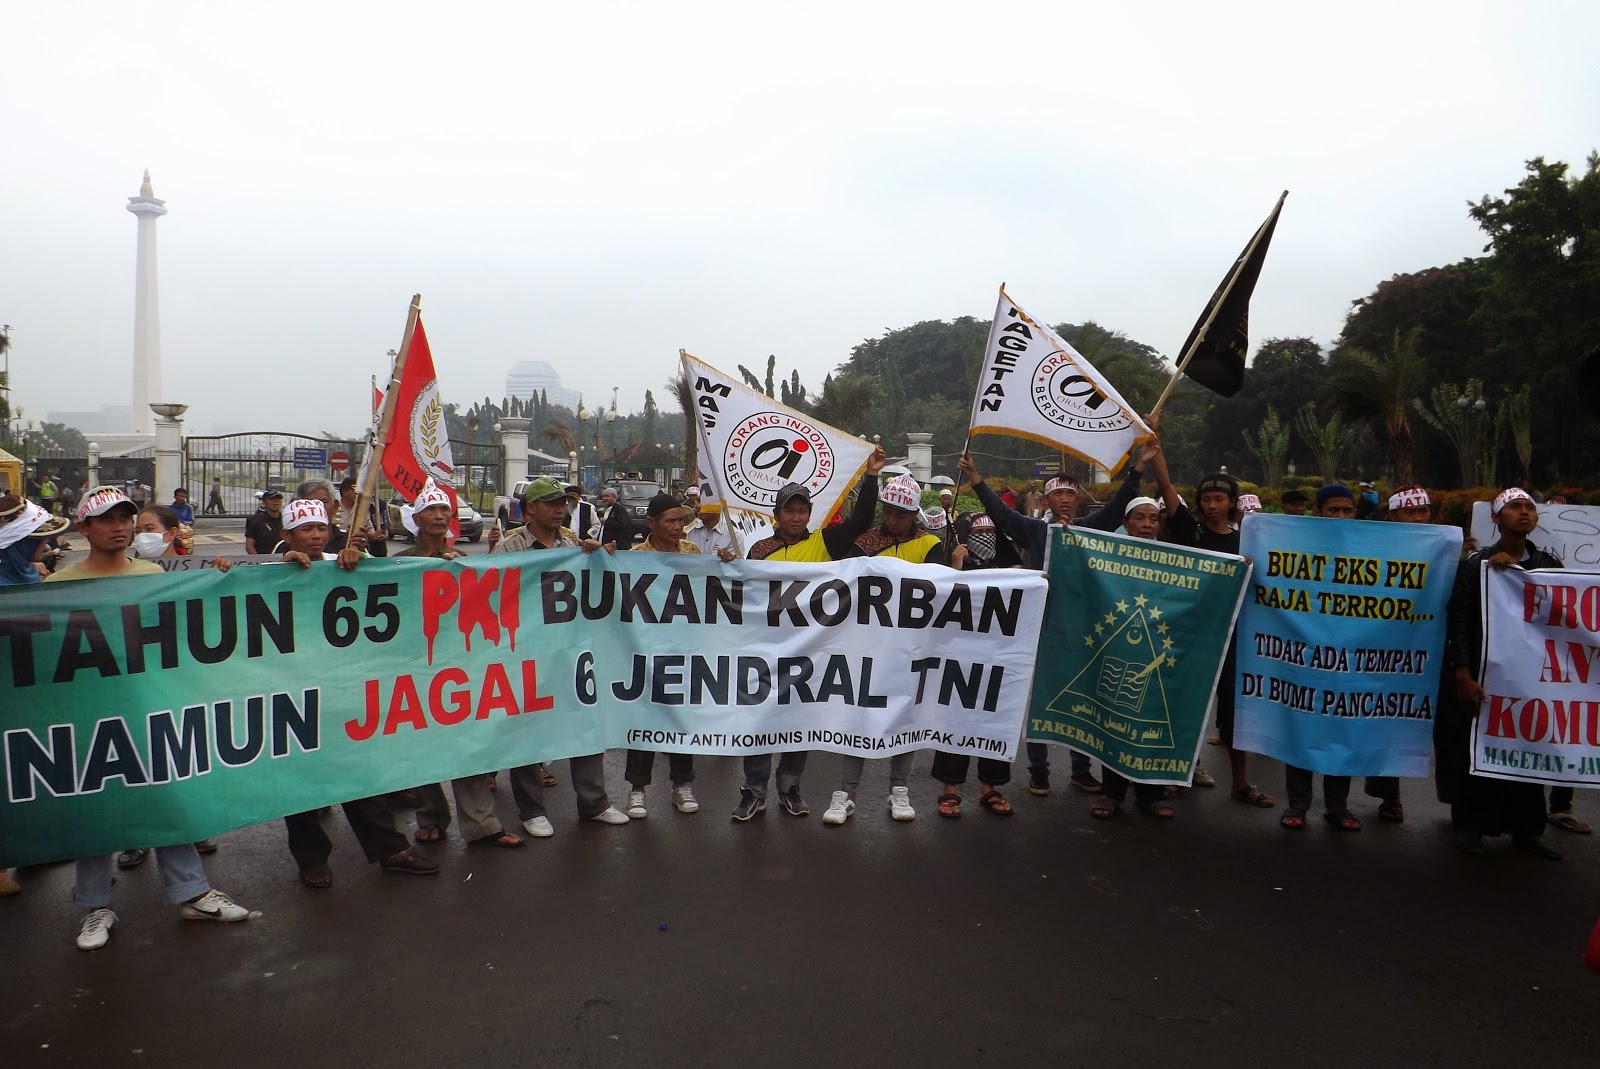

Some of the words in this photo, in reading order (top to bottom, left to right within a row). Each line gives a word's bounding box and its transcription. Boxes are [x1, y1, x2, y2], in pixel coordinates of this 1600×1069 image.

[1036, 385, 1116, 429] BERSATULAH
[732, 415, 780, 448] ORANG
[786, 418, 831, 479] INDONESIA
[883, 492, 913, 506] ATIM
[1061, 532, 1114, 554] YAYASAN
[1118, 544, 1195, 569] PERGURUAN
[1197, 559, 1237, 577] ISLAM
[1087, 557, 1200, 590] COKROKERTOPATI
[1267, 551, 1327, 582] BUAT
[1332, 556, 1379, 587] EKS
[1384, 560, 1428, 590] PKI
[1254, 585, 1310, 613] RAJA
[0, 590, 296, 688] TAHUN
[322, 582, 401, 648] 65
[422, 566, 521, 666] PKI
[540, 568, 745, 626] BUKAN
[765, 572, 1023, 637] KORBAN
[1254, 633, 1306, 667] TIDAK
[1309, 645, 1349, 673] ADA
[1354, 648, 1428, 676] TEMPAT
[1539, 639, 1600, 685] AN
[1242, 673, 1263, 698] DI
[1269, 676, 1316, 714] BUMI
[1322, 690, 1432, 721] PANCASILA
[3, 688, 320, 802] NAMUN
[345, 660, 554, 742] JAGAL
[574, 650, 598, 705] 6
[611, 653, 888, 708] JENDRAL
[911, 656, 1005, 713] TNI
[627, 729, 688, 745] (FRONT
[690, 733, 726, 747] ANTI
[731, 731, 803, 747] KOMUNIS
[807, 730, 886, 750] INDONESIA
[888, 729, 953, 749] JATIM/FAK
[957, 735, 1007, 756] JATIM)
[1031, 718, 1105, 750] TAKERAN
[1118, 752, 1190, 775] MAGETAN
[1482, 746, 1565, 774] MAGETAN
